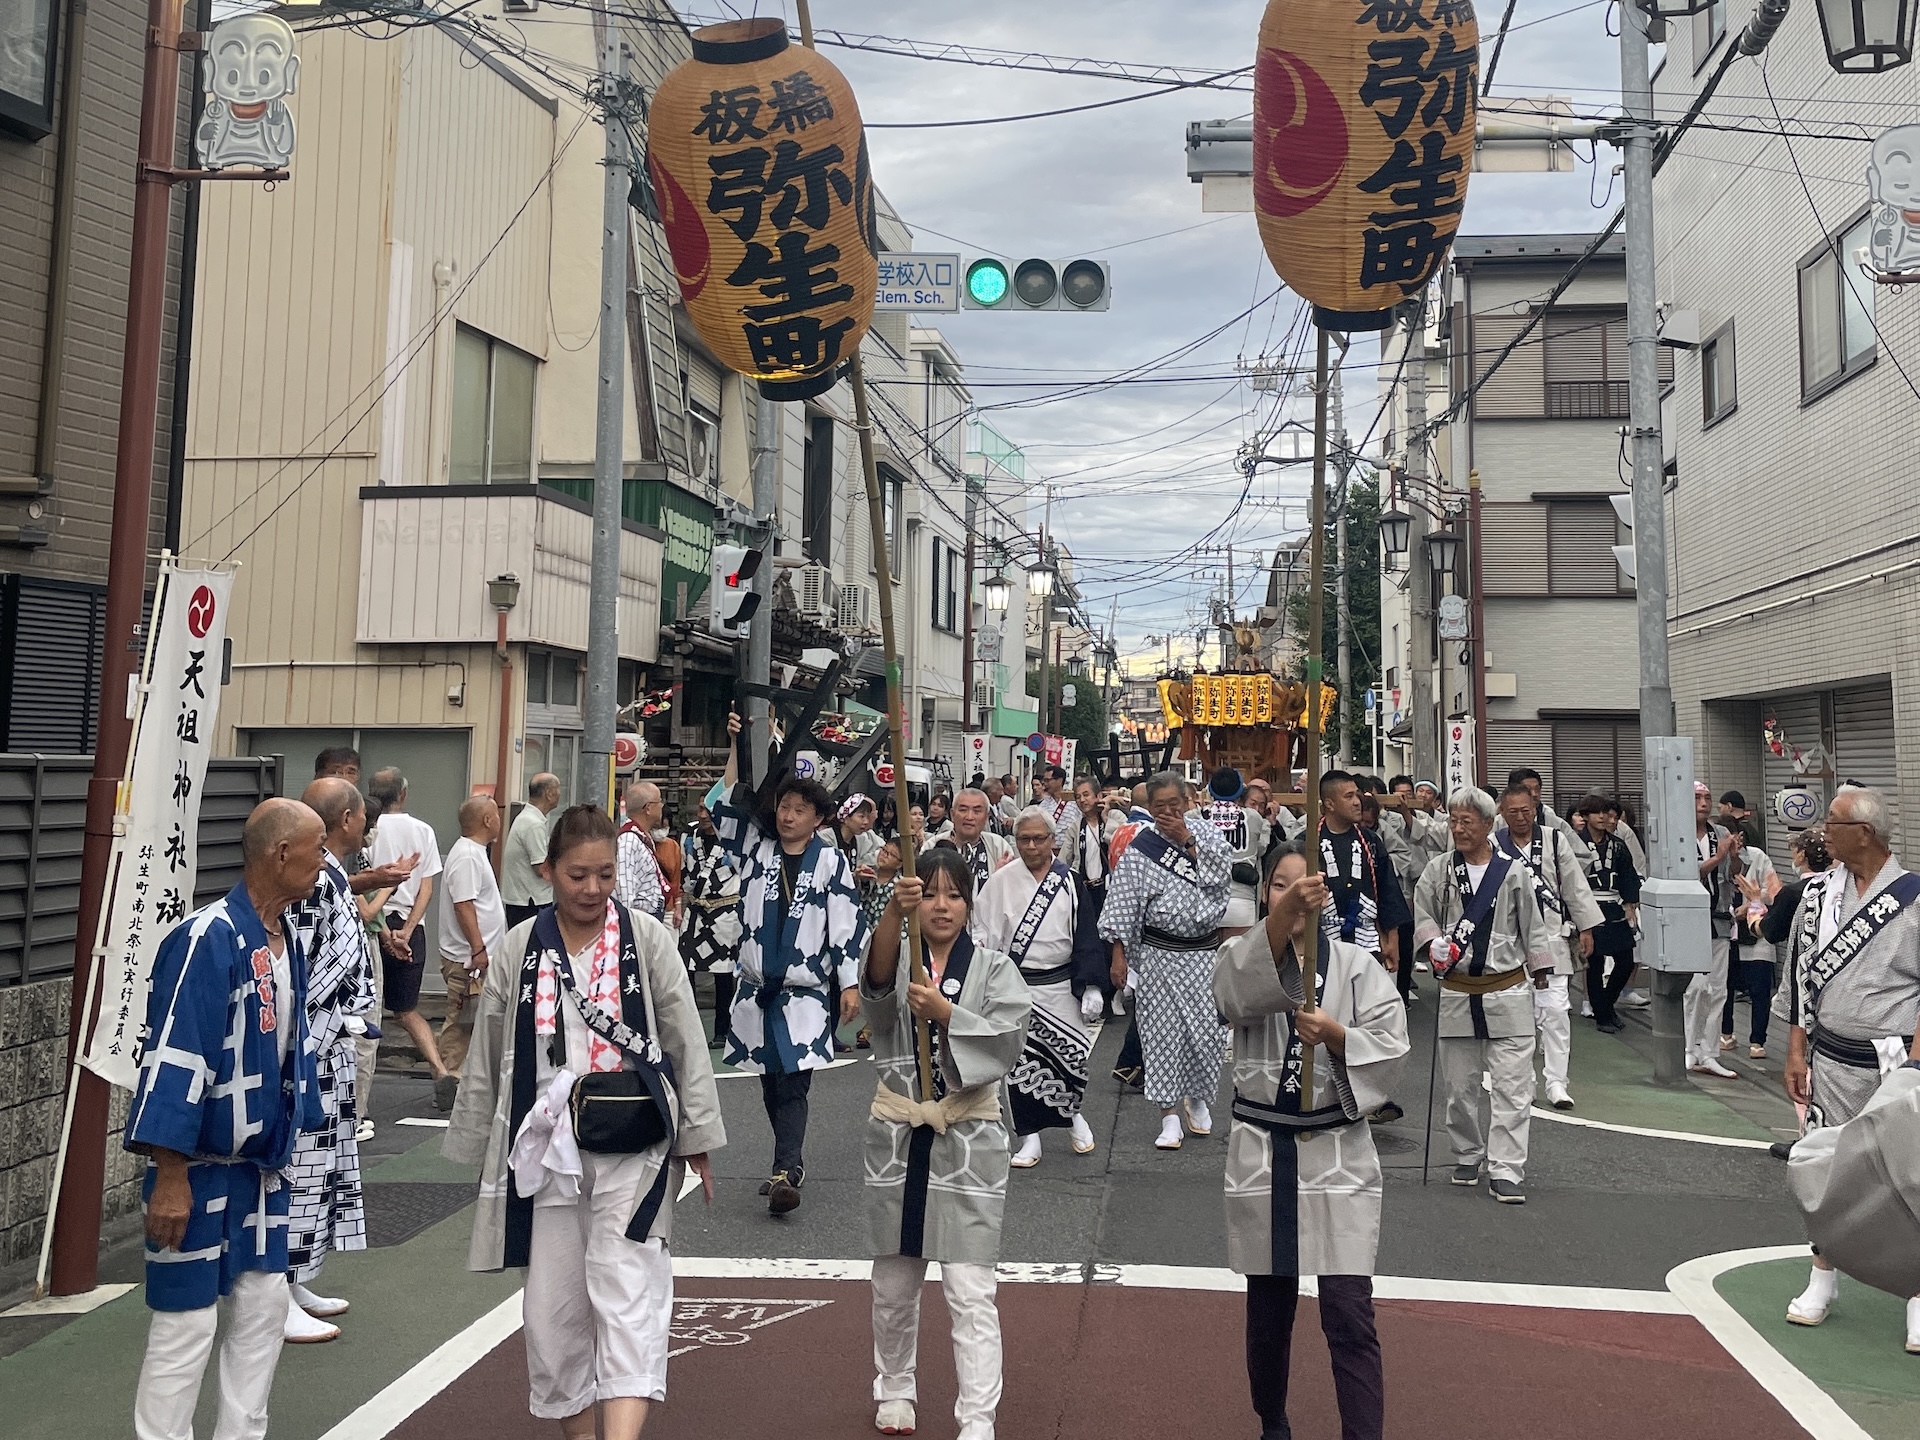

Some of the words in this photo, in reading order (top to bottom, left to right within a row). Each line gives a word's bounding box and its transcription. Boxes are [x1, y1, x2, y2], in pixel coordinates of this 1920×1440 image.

[691, 69, 835, 145] 板橋
[1358, 31, 1479, 296] 弥生町
[706, 139, 856, 377] 弥生町
[878, 261, 951, 287] 学校入口
[914, 290, 945, 304] Sch.
[1193, 686, 1205, 718] 弥生町
[1209, 687, 1221, 720] 弥生町
[1225, 686, 1237, 718] 弥生町
[1241, 686, 1253, 719] 弥生町
[1257, 684, 1270, 717] 弥生町
